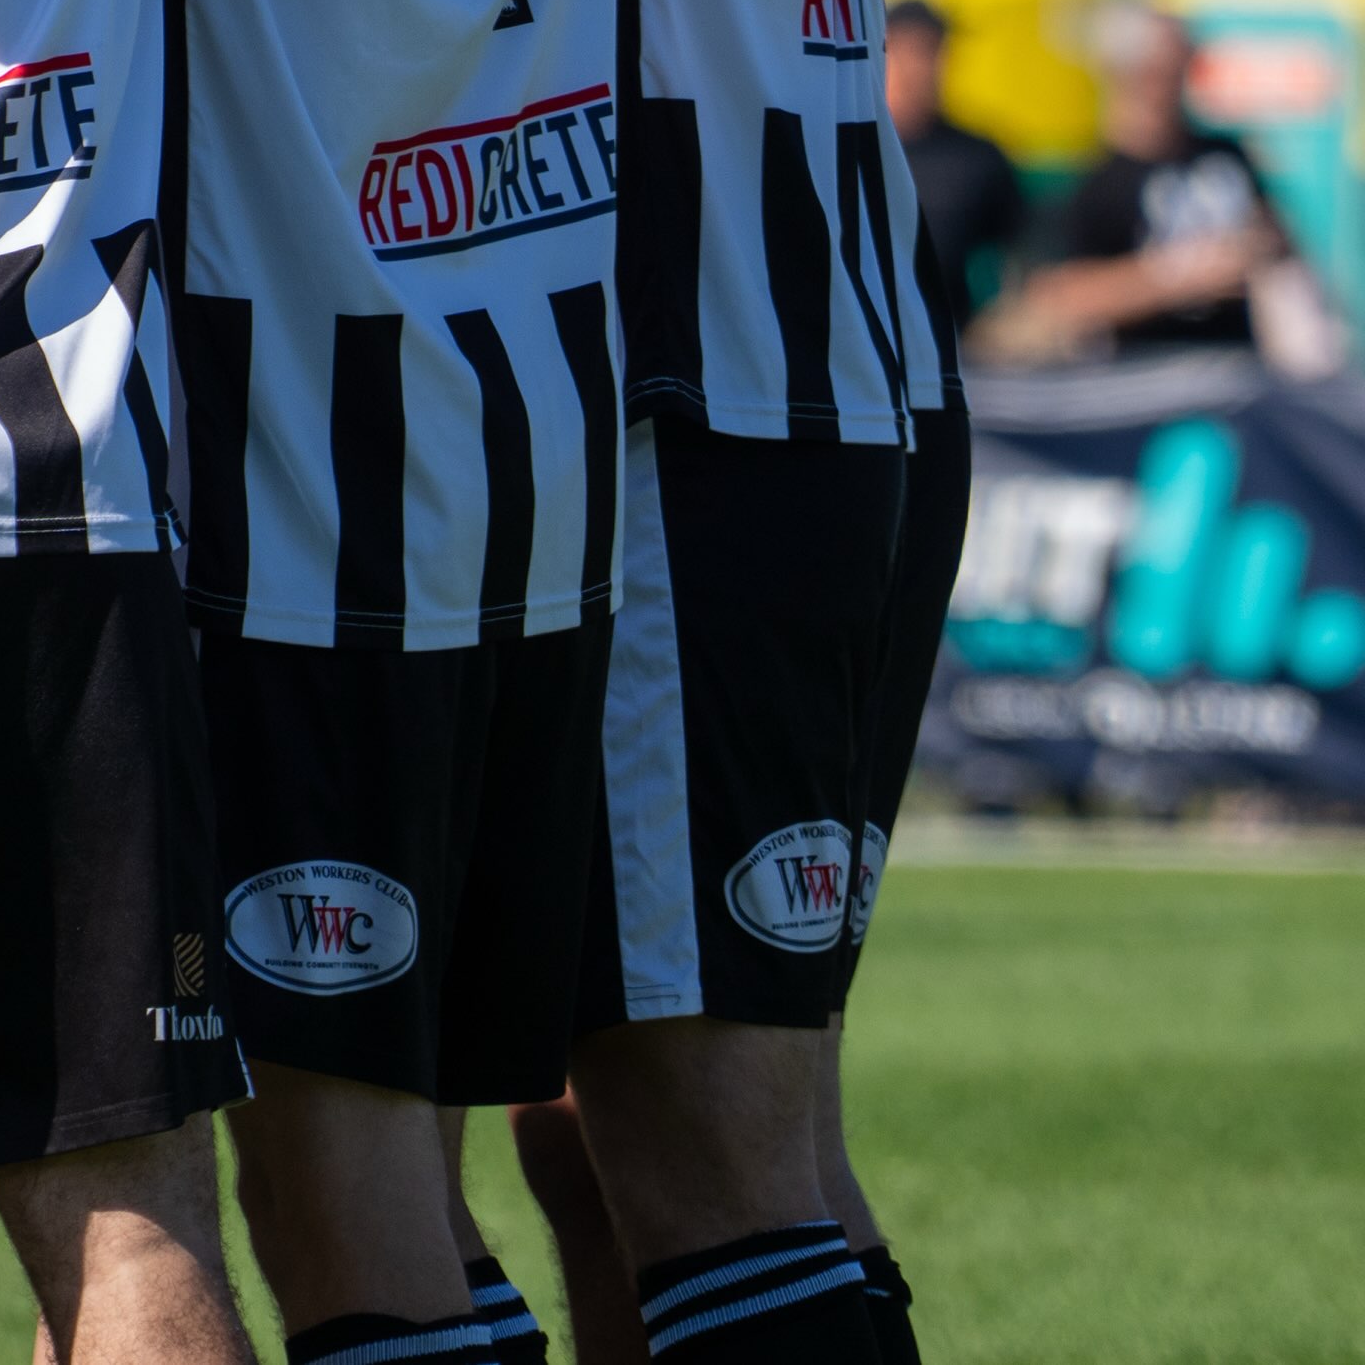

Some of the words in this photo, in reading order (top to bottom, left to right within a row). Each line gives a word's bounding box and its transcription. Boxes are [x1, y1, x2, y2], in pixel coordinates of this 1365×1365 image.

[359, 100, 617, 246] REDICRETE
[748, 830, 796, 867] WESTON
[244, 867, 306, 897] WESTON
[311, 865, 373, 885] WORKERS
[374, 877, 410, 908] CLUB
